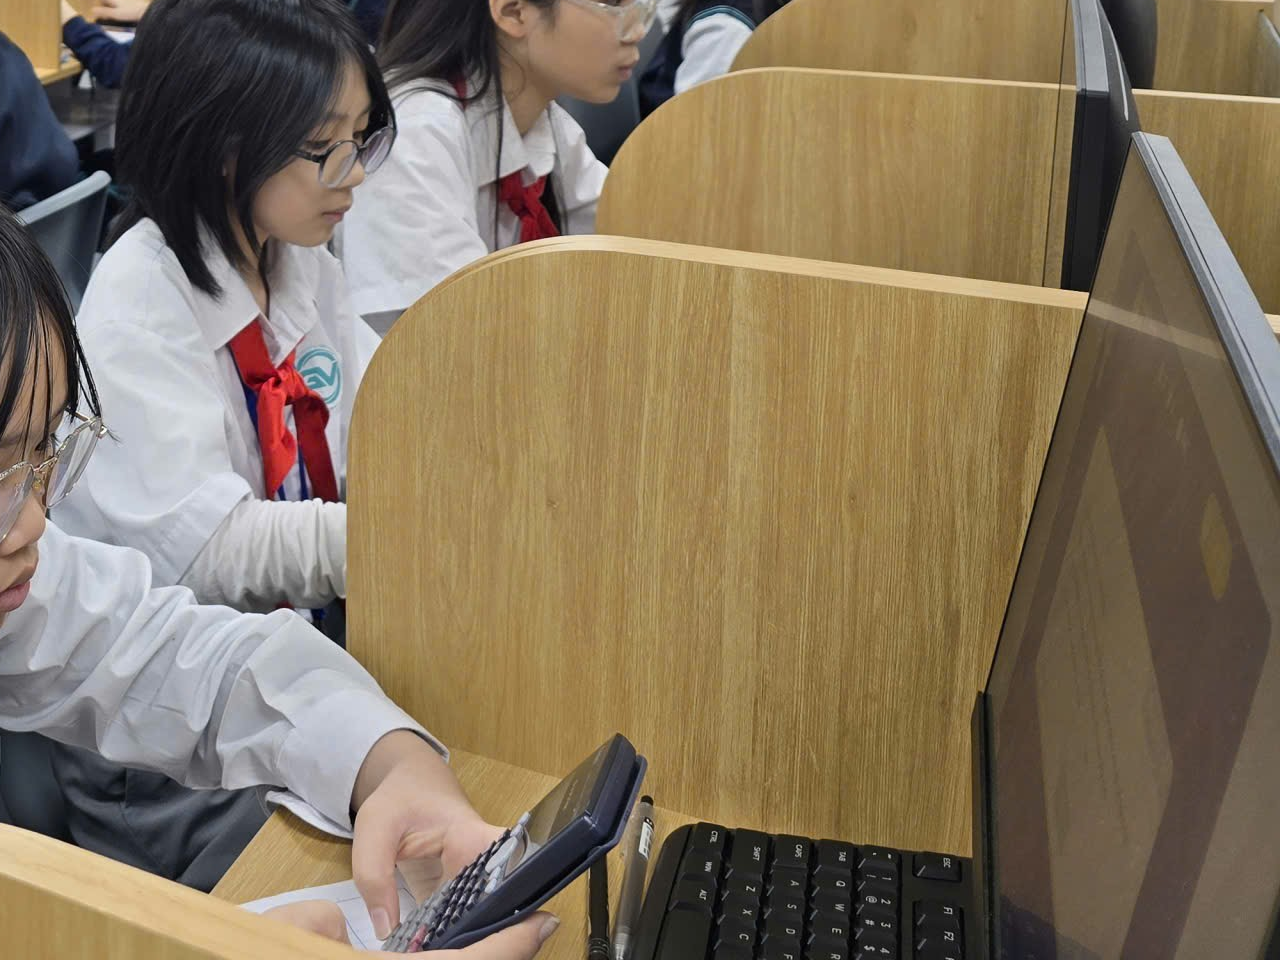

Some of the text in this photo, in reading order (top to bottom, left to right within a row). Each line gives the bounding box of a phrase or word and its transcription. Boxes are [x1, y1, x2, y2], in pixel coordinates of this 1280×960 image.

[943, 857, 951, 869] ESC
[742, 908, 752, 916] X
[943, 906, 953, 915] F1
[785, 927, 796, 935] D
[831, 927, 842, 935] E
[739, 933, 749, 941] C
[944, 931, 954, 941] F2
